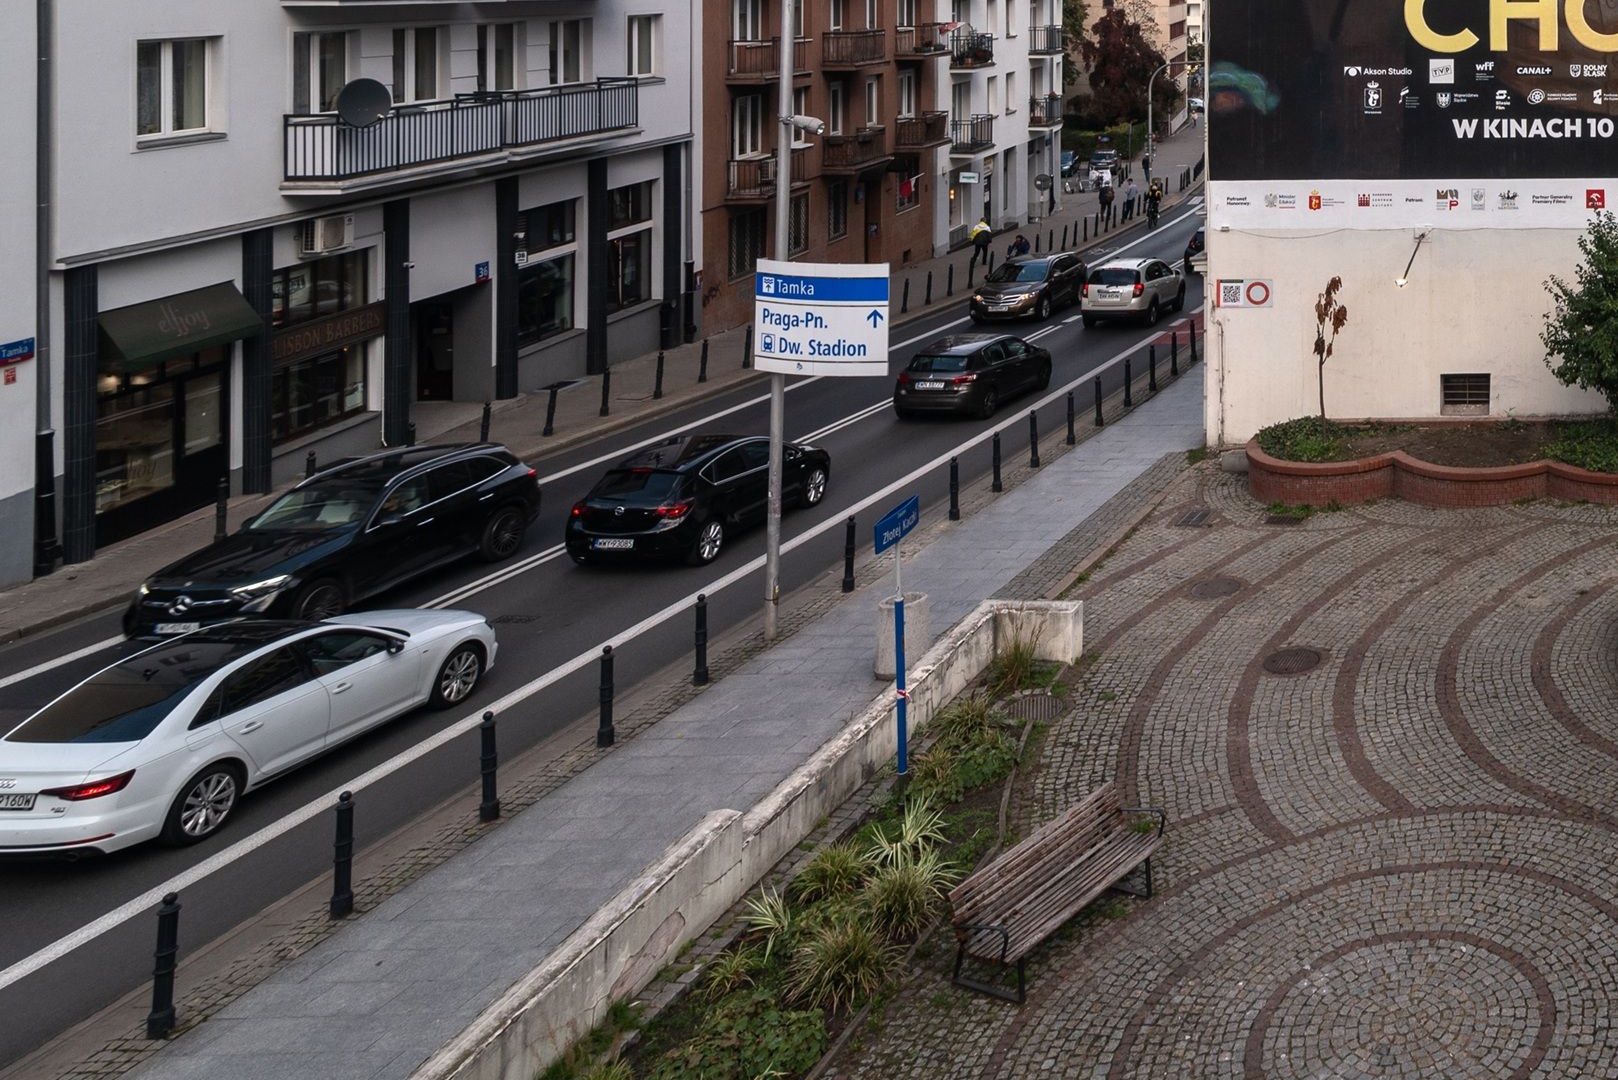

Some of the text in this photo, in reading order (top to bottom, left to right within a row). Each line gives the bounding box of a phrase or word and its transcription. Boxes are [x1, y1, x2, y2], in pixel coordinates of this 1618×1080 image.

[1388, 67, 1412, 75] Studio
[1517, 67, 1552, 75] CANAL+
[1452, 119, 1479, 138] W
[1484, 118, 1582, 138] KINACH
[1587, 118, 1614, 138] 10
[777, 280, 814, 296] Tamka
[762, 308, 828, 331] Praga-Pn.
[779, 337, 867, 357] Dw. Stadion
